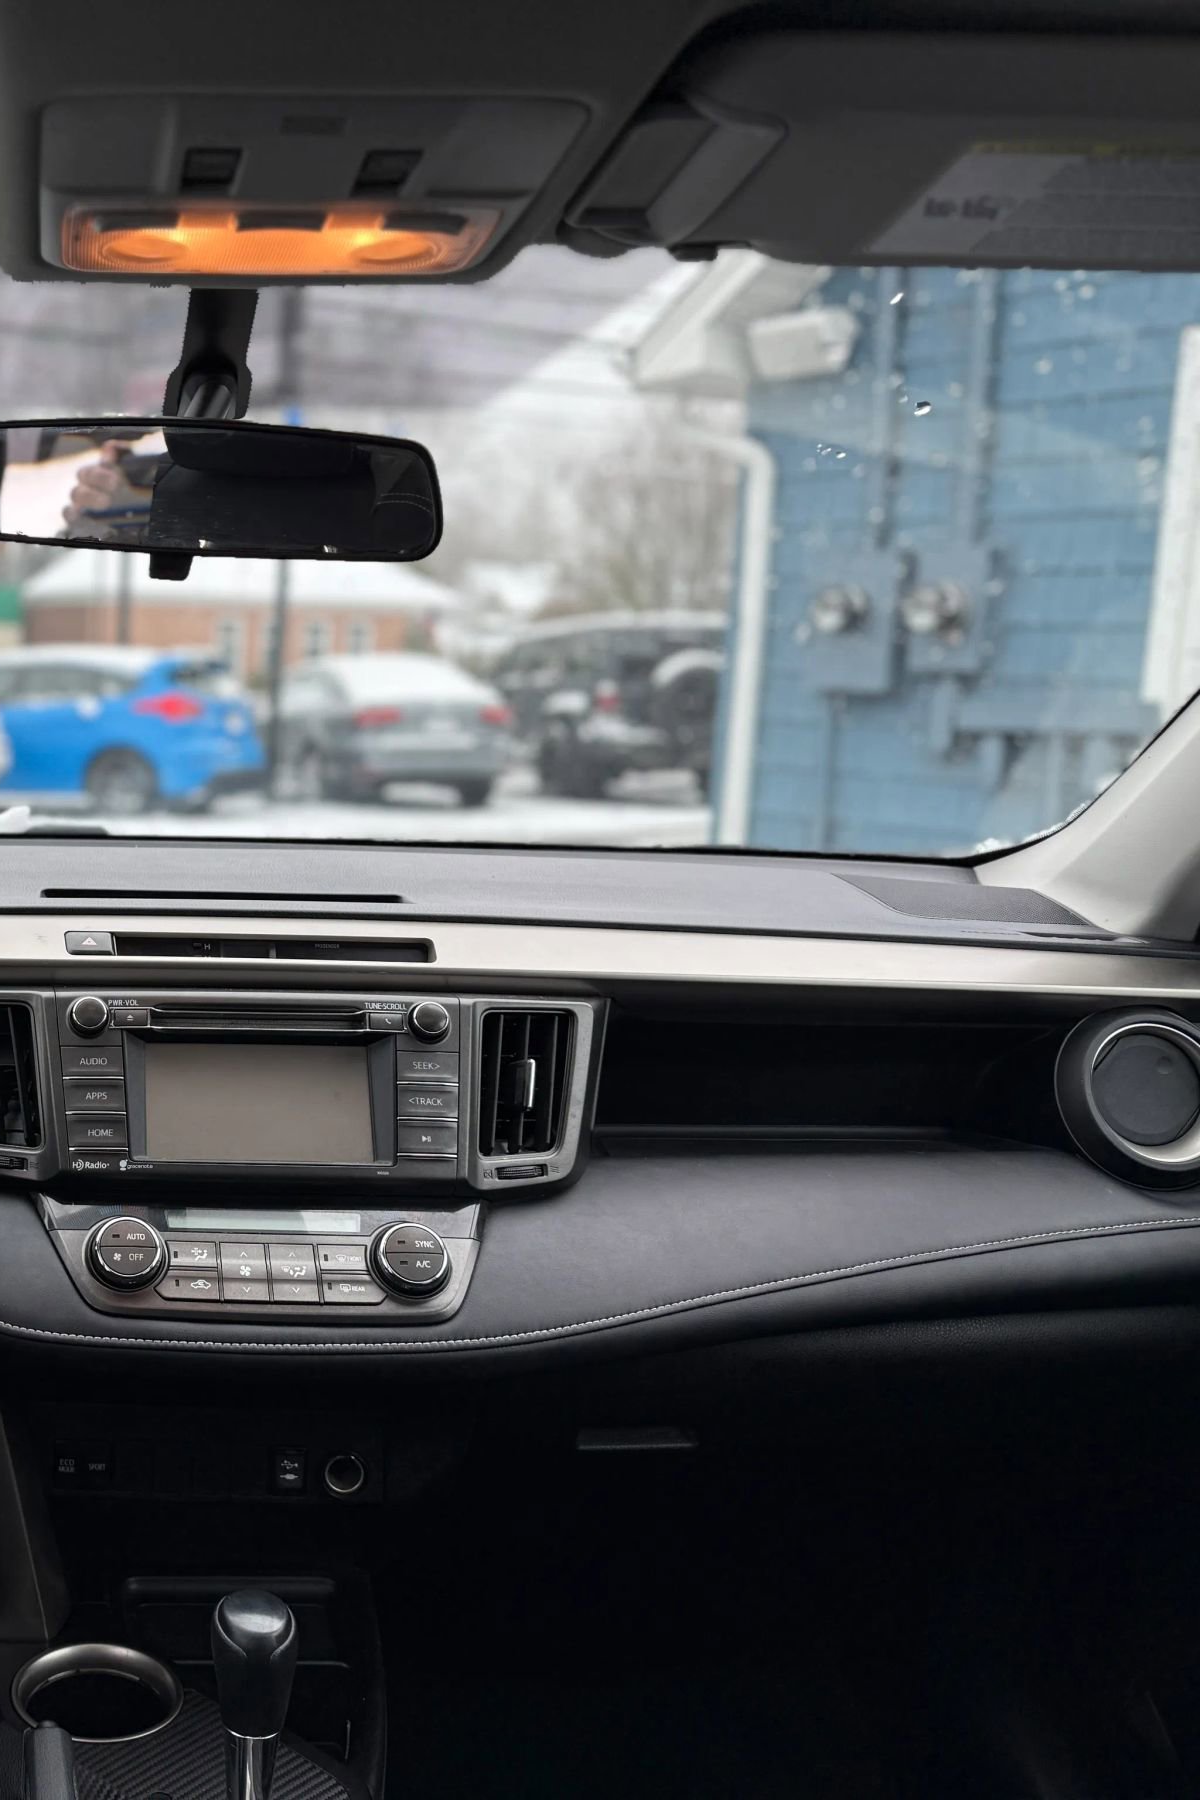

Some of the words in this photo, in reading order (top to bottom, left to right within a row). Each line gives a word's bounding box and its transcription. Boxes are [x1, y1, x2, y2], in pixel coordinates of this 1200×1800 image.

[79, 1057, 108, 1066] AUDIO
[85, 1091, 108, 1100] APPS
[87, 1129, 113, 1137] HOME
[126, 1233, 146, 1241] AUTO
[415, 1240, 435, 1249] SYNC
[128, 1253, 144, 1261] OFF
[415, 1260, 431, 1268] A/C
[59, 1458, 75, 1466] ECO
